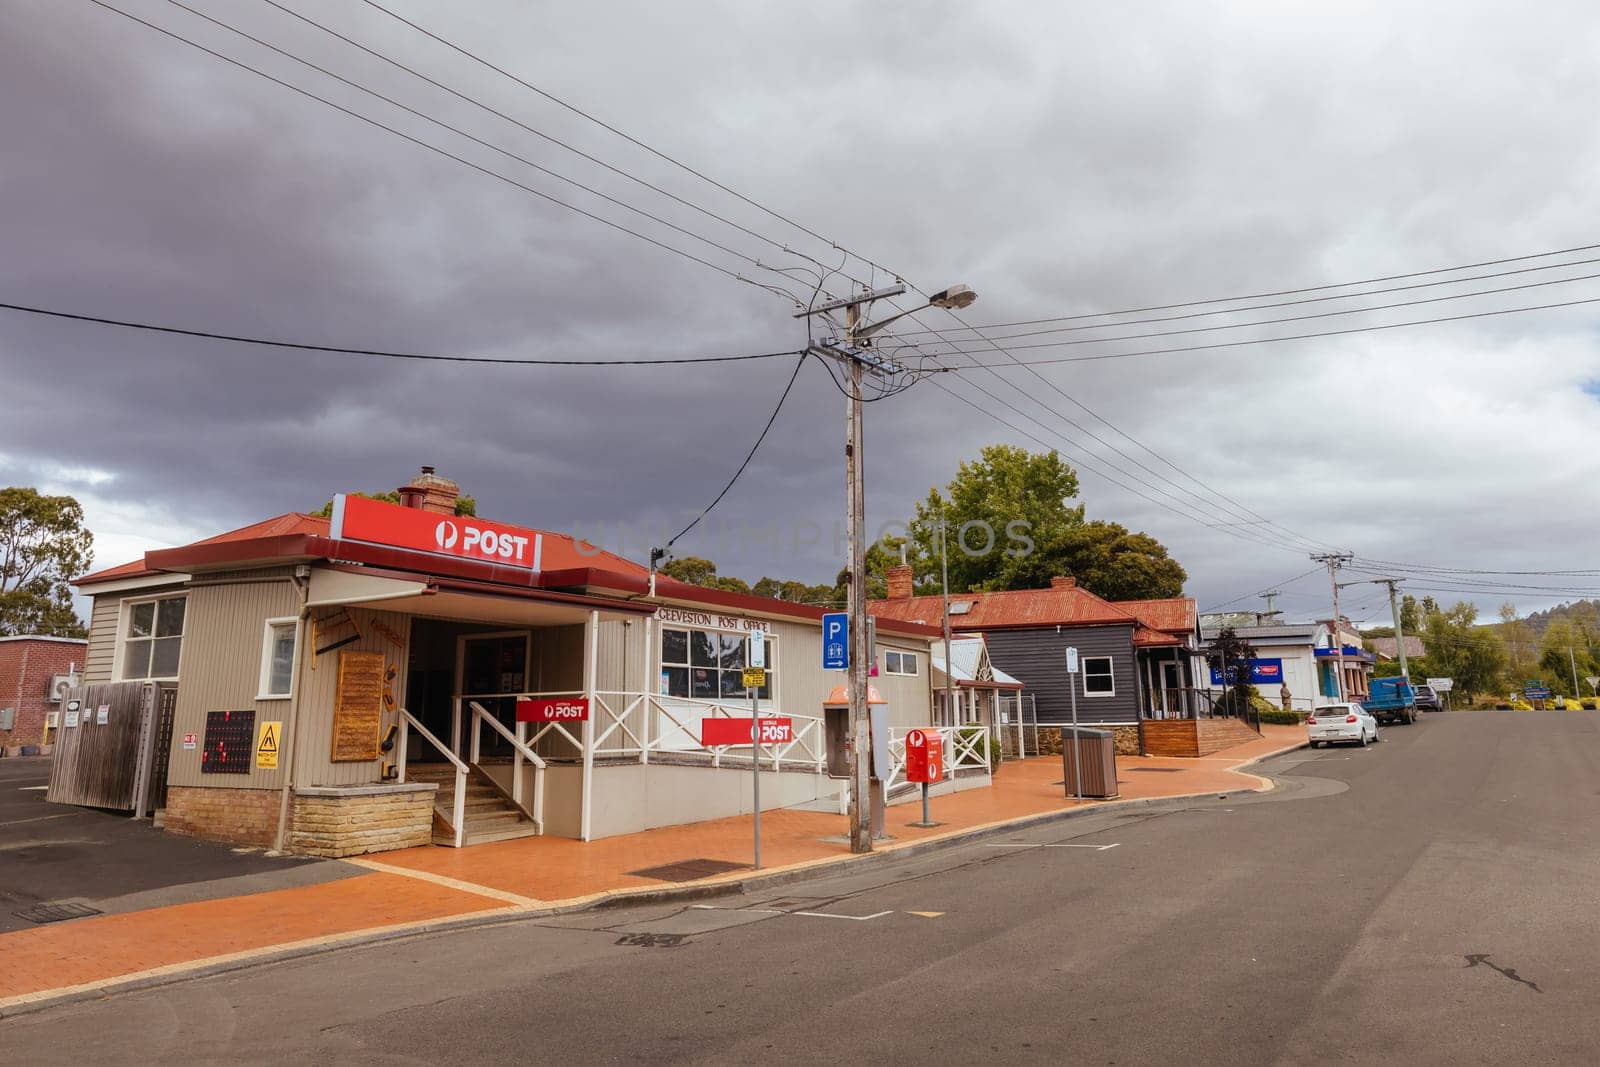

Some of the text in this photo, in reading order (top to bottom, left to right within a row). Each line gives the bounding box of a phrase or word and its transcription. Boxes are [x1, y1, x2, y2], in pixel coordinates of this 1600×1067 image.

[463, 526, 528, 560] POST
[659, 608, 712, 625] GEEVESTON
[718, 616, 738, 629] POST
[829, 622, 841, 640] P
[555, 706, 584, 718] POST
[762, 725, 789, 741] POST
